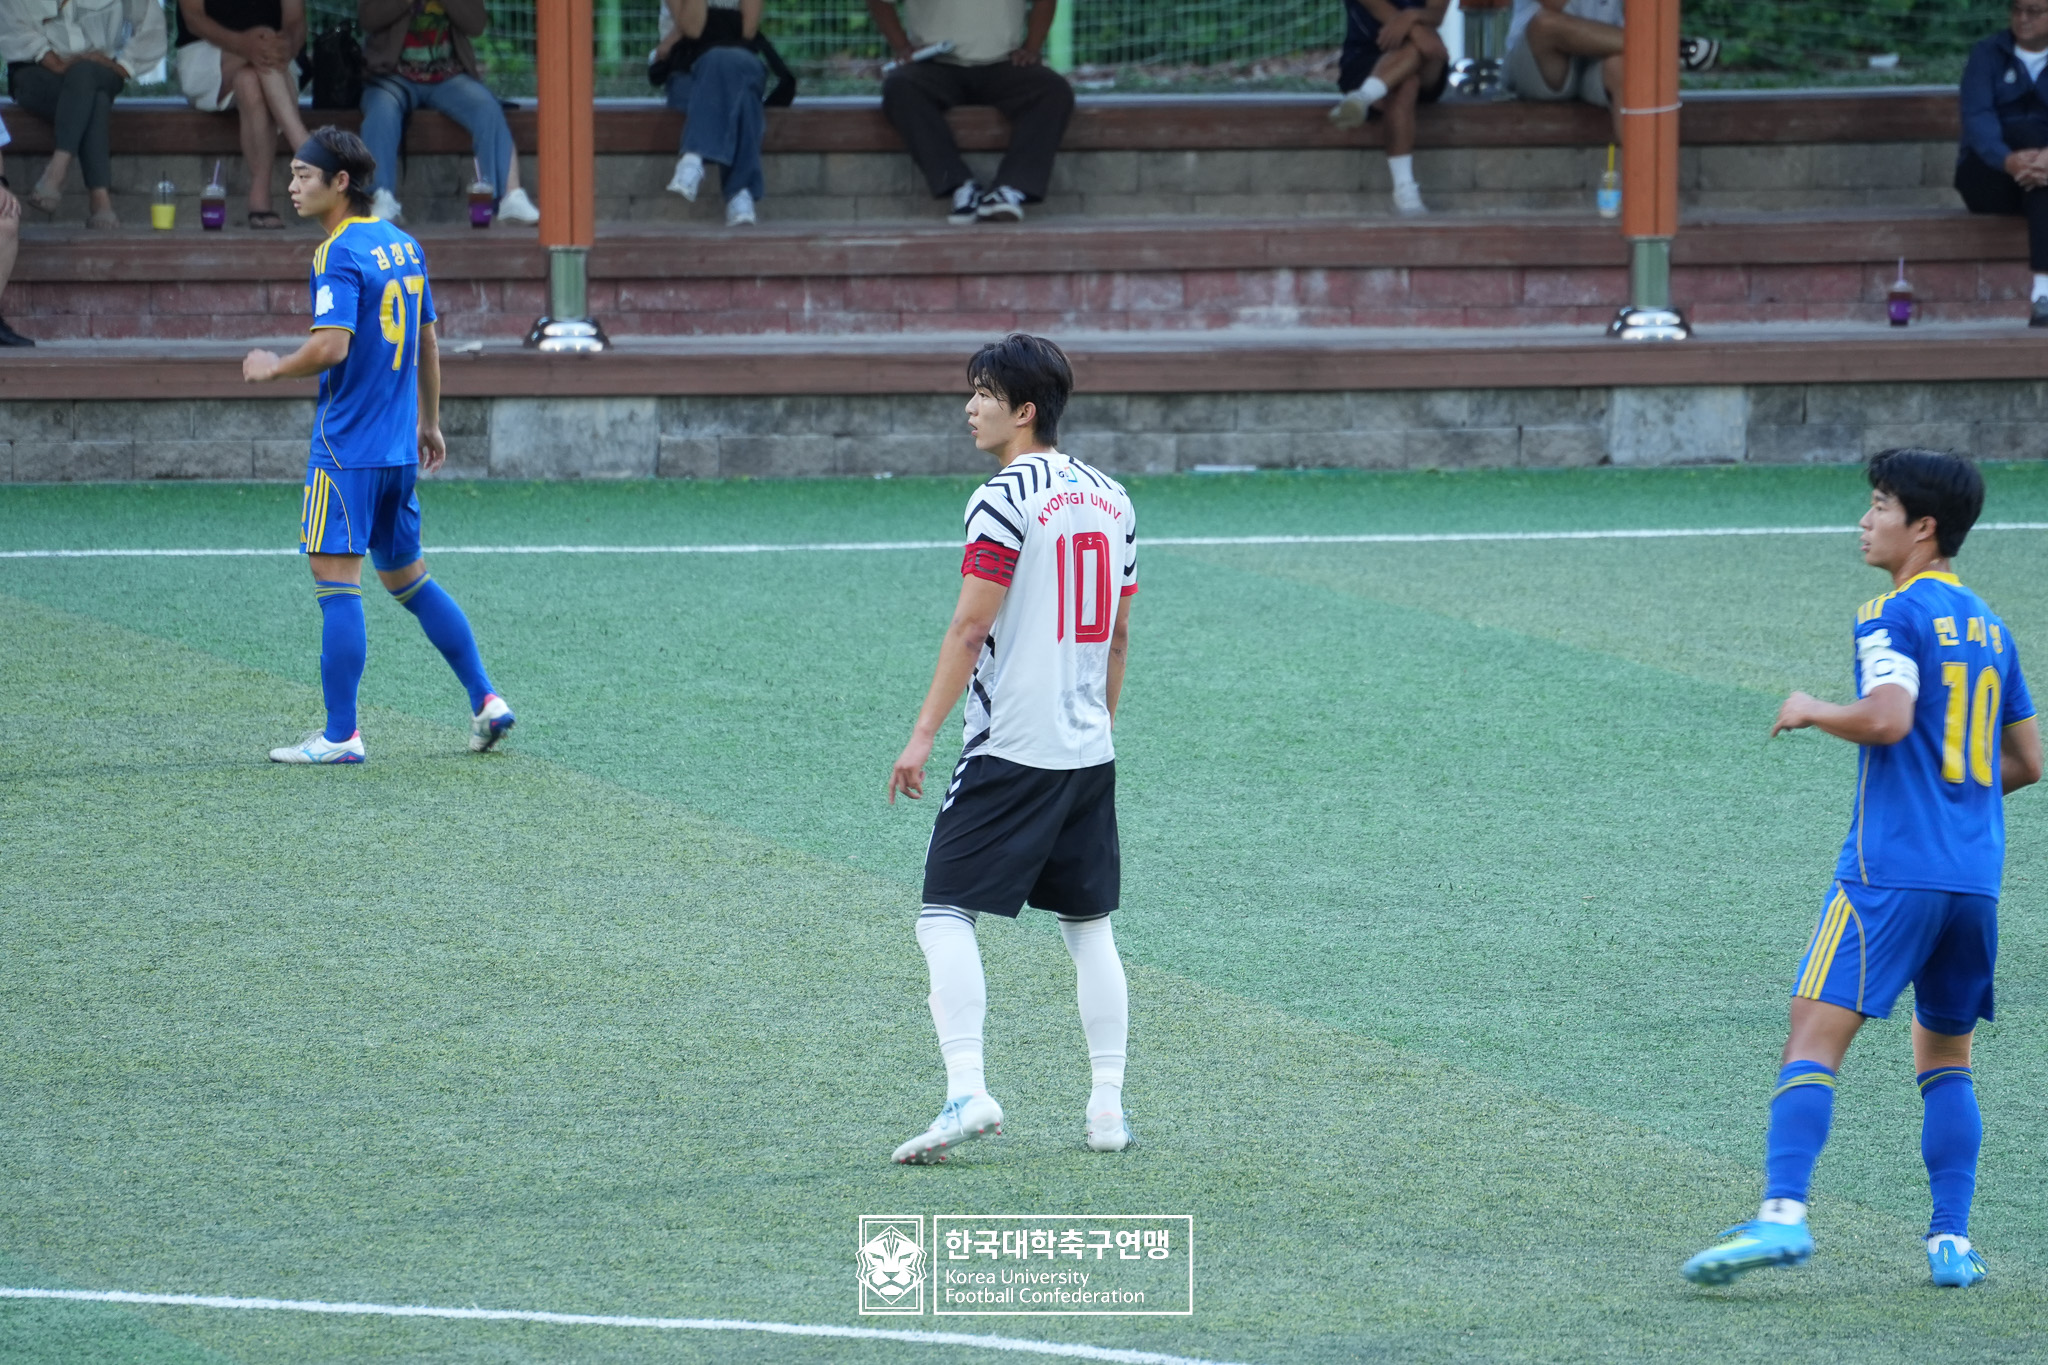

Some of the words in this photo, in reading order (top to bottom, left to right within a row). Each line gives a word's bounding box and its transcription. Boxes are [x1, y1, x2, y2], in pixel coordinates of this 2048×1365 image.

[379, 275, 425, 371] 97
[1037, 491, 1085, 527] KYONGGI
[974, 549, 1000, 575] C
[1056, 531, 1113, 645] 10
[1940, 661, 2002, 788] 10
